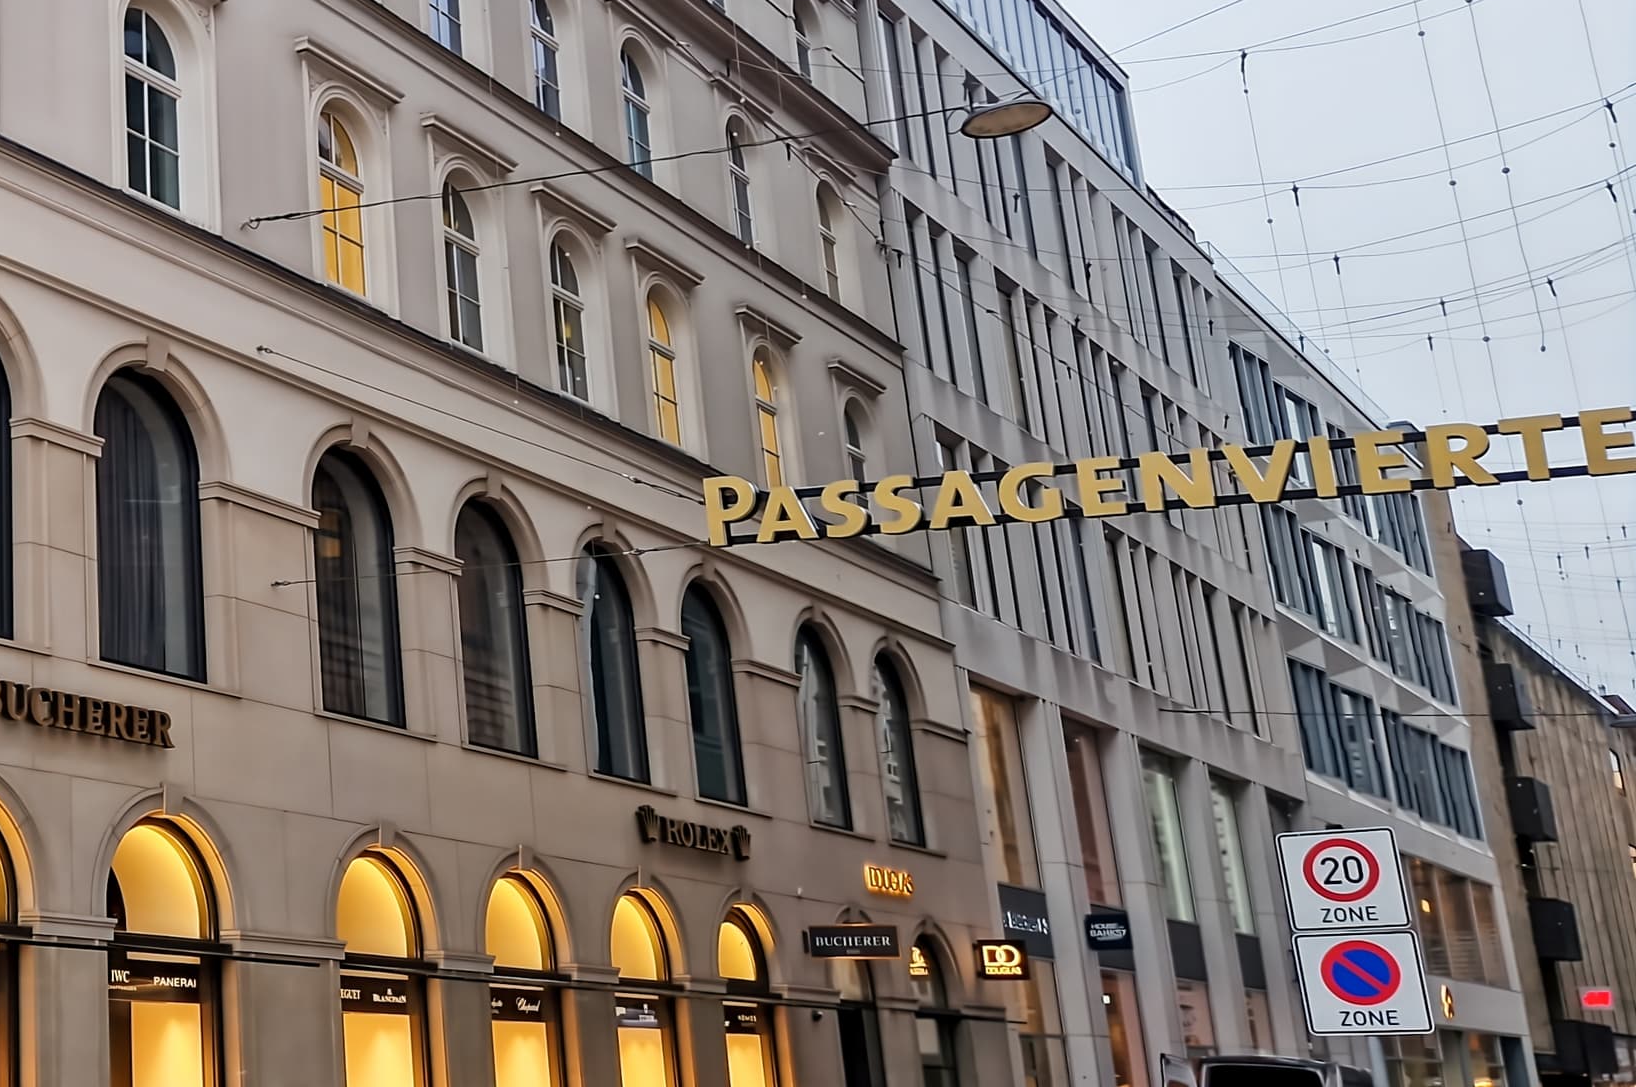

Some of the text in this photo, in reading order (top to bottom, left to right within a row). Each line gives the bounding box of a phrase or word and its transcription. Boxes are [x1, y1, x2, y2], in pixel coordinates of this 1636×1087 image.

[704, 407, 1636, 548] PASSAGENVIERTE
[667, 818, 730, 855] ROLEX
[1320, 856, 1364, 885] 20
[1320, 906, 1379, 923] ZONE
[815, 936, 891, 948] BUCHERER
[111, 969, 130, 983] IWC
[153, 976, 197, 989] PANERAI
[1339, 1010, 1400, 1026] ZONE
